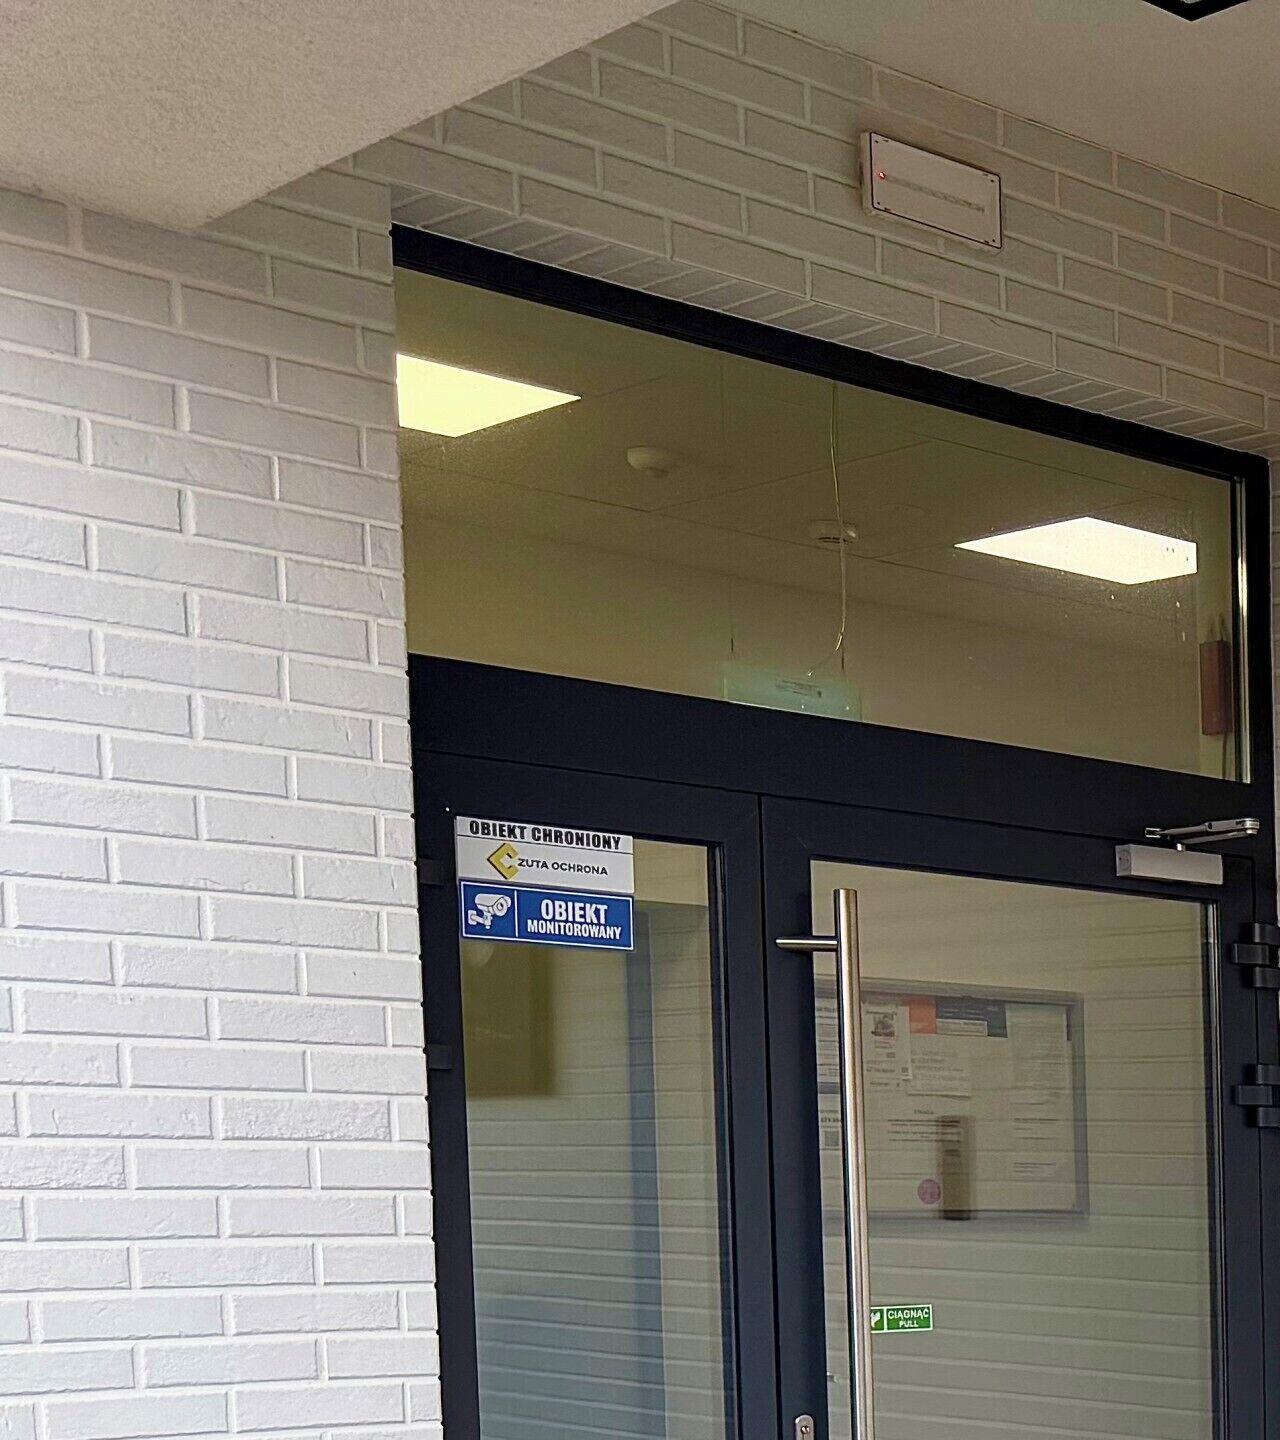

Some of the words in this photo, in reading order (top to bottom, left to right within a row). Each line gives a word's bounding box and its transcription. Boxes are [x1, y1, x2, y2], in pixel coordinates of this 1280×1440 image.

[469, 820, 527, 840] OBIEKT
[531, 827, 621, 850] CHRONIONY
[551, 861, 608, 876] OCHRONA
[540, 899, 609, 924] OBIEKT
[527, 919, 622, 940] MONITOROWANY
[899, 1320, 919, 1328] PULL
